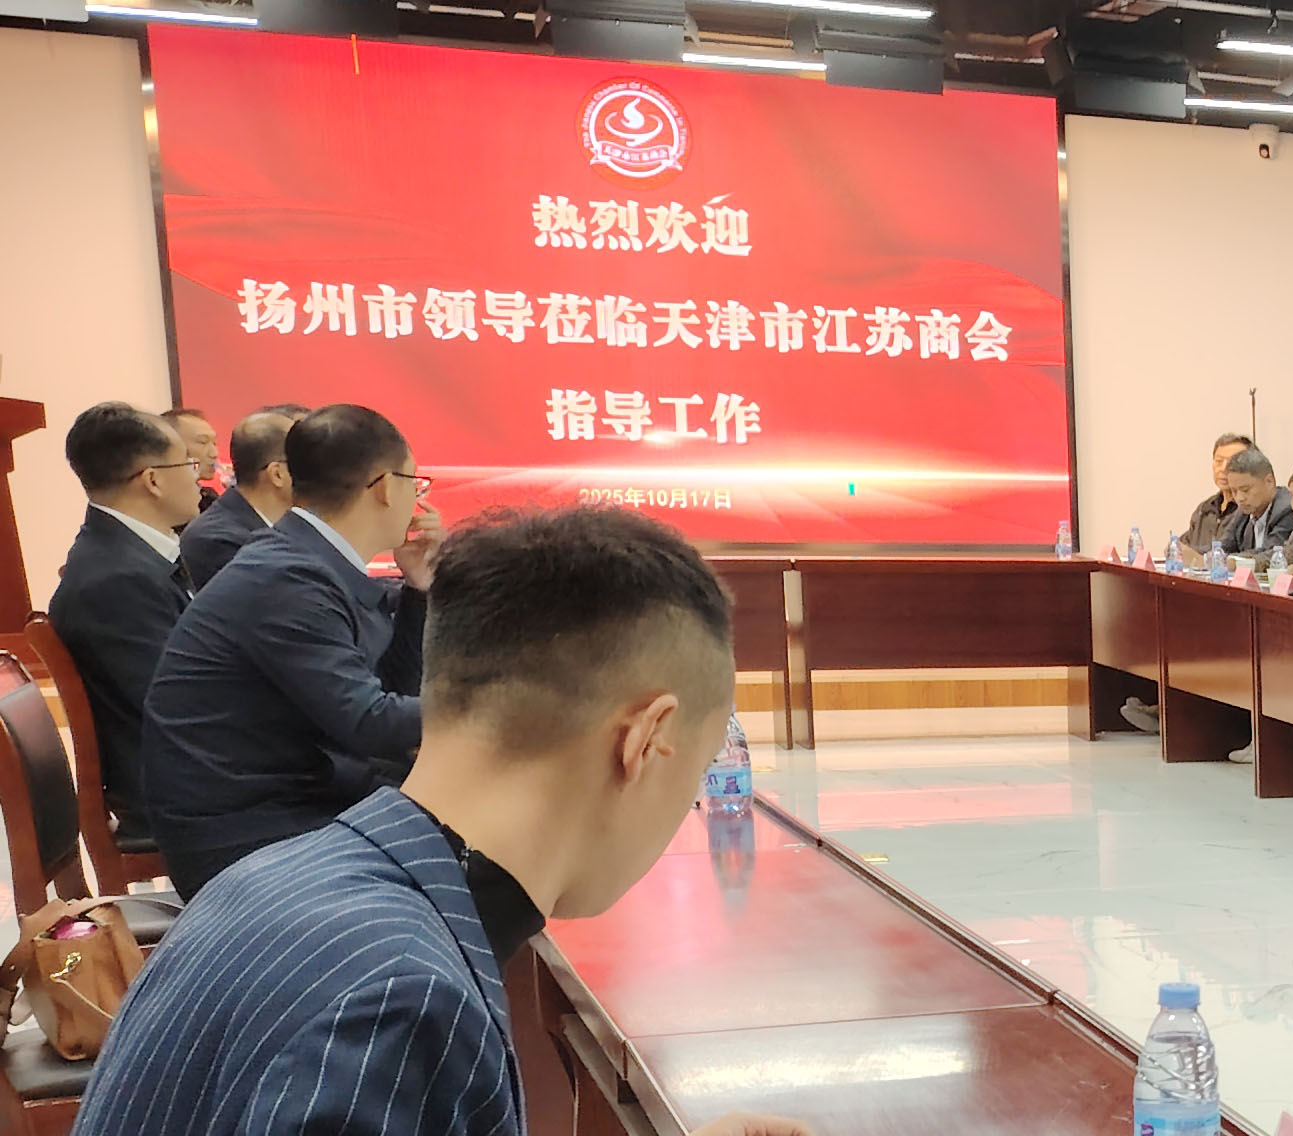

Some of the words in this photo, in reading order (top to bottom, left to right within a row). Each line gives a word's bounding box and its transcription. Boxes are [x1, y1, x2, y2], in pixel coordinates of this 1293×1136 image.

[531, 193, 752, 258] 热烈欢迎
[236, 278, 1014, 363] 扬州市领导莅临天津市江苏商会
[545, 388, 763, 446] 指导工作
[578, 486, 732, 510] 2025年10月17日
